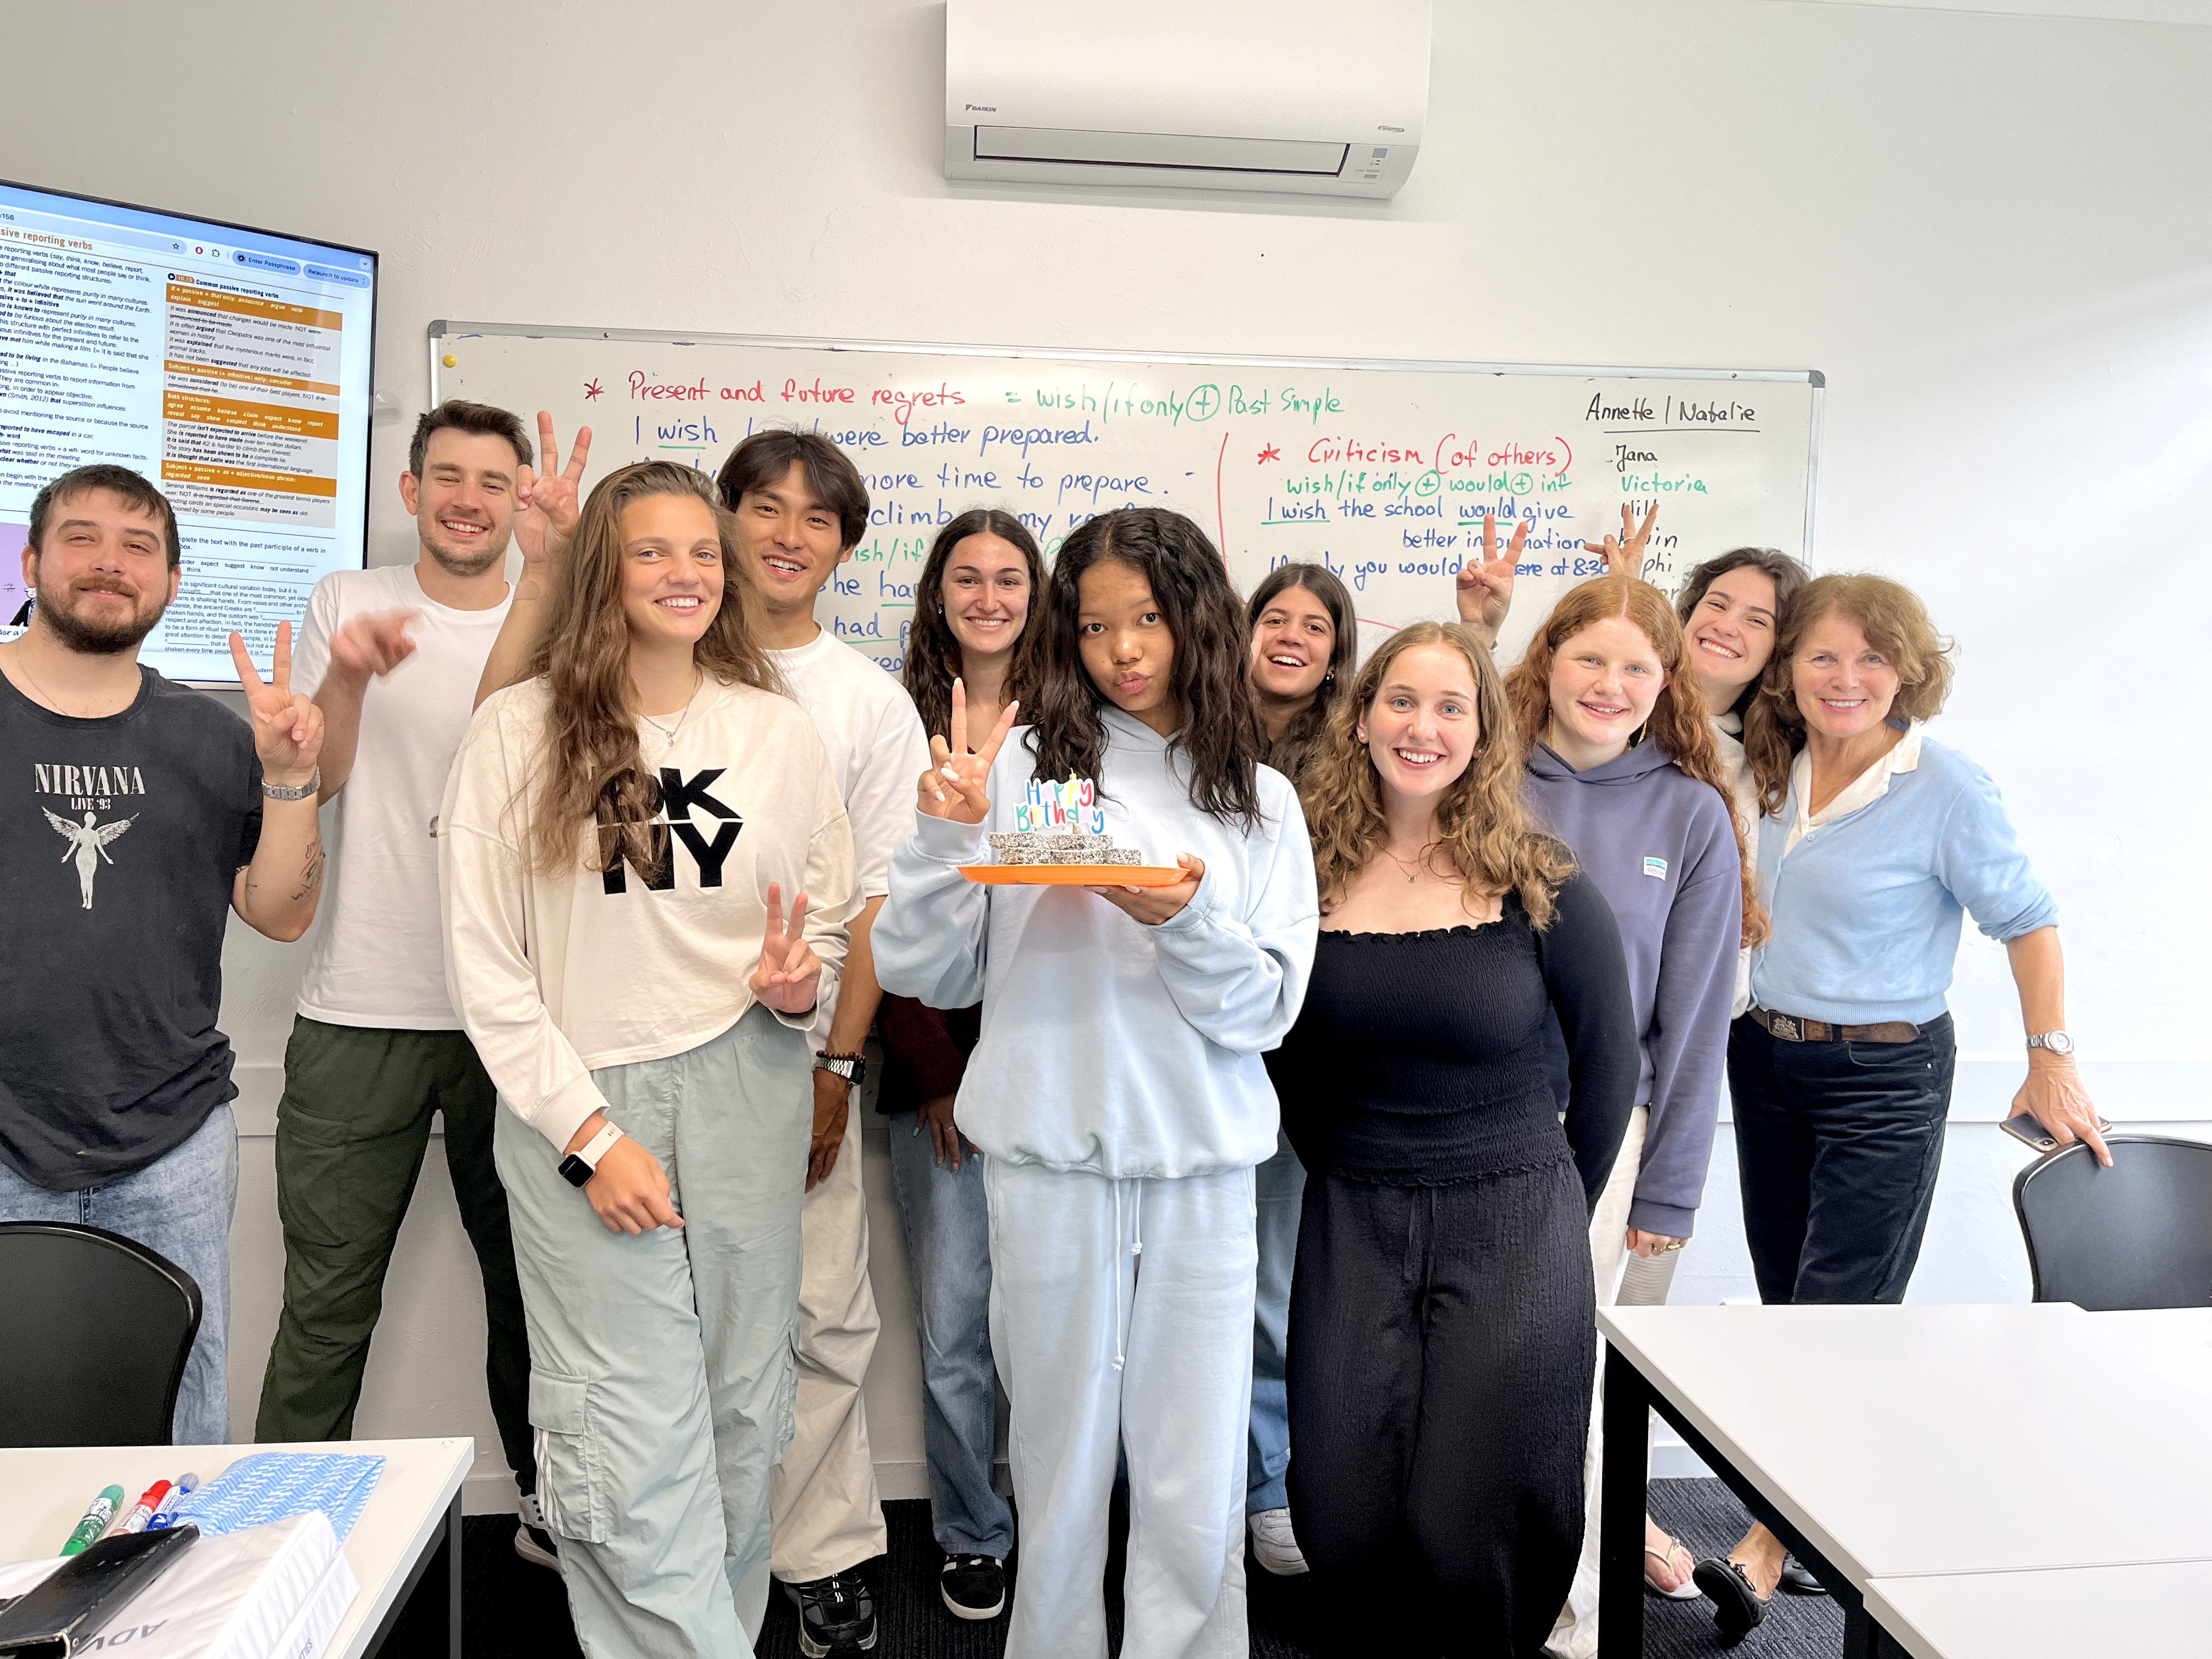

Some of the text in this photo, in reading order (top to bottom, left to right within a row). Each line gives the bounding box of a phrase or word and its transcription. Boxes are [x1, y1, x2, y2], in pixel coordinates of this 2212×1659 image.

[1, 227, 93, 251] sive reporting verbs
[264, 259, 296, 271] Passphrase
[308, 268, 333, 278] Relaunch
[181, 395, 211, 404] structures:
[628, 371, 712, 403] Present
[720, 380, 766, 404] and
[780, 379, 855, 405] future
[871, 382, 966, 425] regrets
[1229, 385, 1272, 415] Past
[1280, 387, 1346, 425] Simple
[217, 408, 238, 416] believe
[1679, 401, 1756, 425] Natalie
[272, 424, 301, 432] understand
[658, 415, 718, 443] wish
[901, 421, 970, 447] better
[1308, 437, 1424, 464] Criticism
[936, 462, 1002, 490] time
[1017, 462, 1043, 490] to
[1621, 473, 1708, 495] Victoria
[871, 498, 954, 526] climb
[1018, 512, 1053, 543] my
[1282, 498, 1327, 520] wish
[1338, 498, 1376, 518] the
[1384, 495, 1443, 518] school
[1522, 501, 1576, 534] give
[1402, 528, 1458, 549] better
[854, 538, 925, 571] ish/if
[1353, 561, 1387, 592] you
[1399, 554, 1463, 577] would
[1550, 557, 1570, 575] at
[34, 763, 146, 797] NIRVANA
[70, 797, 94, 811] LIVE
[1026, 781, 1092, 808] Happy
[1016, 800, 1104, 834] Birthday
